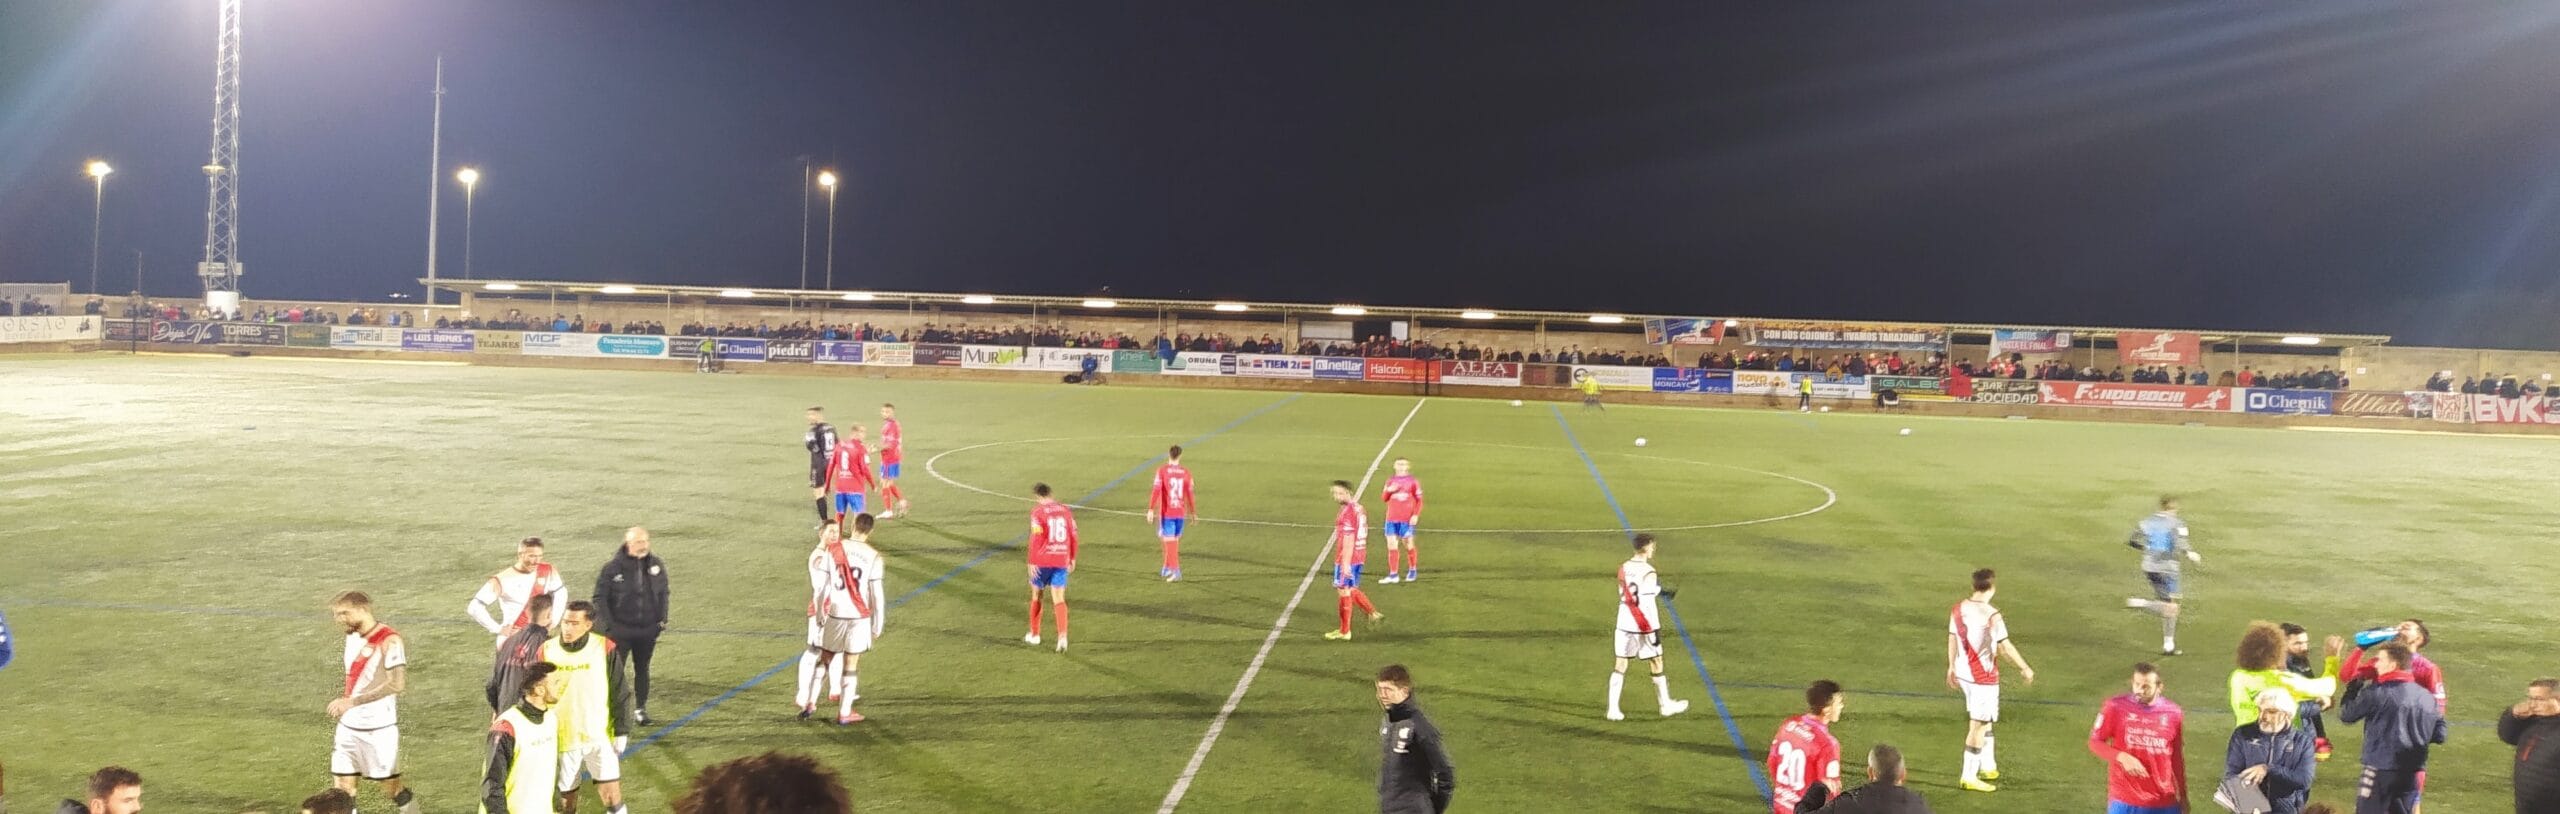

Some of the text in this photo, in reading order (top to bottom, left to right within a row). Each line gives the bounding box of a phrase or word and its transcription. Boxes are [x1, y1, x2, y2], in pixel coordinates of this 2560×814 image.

[222, 325, 262, 336] TORRES
[1763, 329, 1781, 340] CON
[1782, 330, 1798, 340] DOS
[1799, 331, 1835, 341] COJONES
[413, 333, 431, 342] LUIS
[476, 338, 520, 349] TEJARES
[524, 333, 561, 343] MCF
[1264, 360, 1289, 369] TIEN
[1370, 361, 1404, 375] Halcón
[1451, 361, 1507, 374] ALFA
[1976, 392, 2038, 404] SOCIEDAD
[2268, 394, 2327, 409] Chemik
[1169, 477, 1184, 499] 21
[1048, 516, 1067, 542] 16
[1776, 740, 1806, 791] 20
